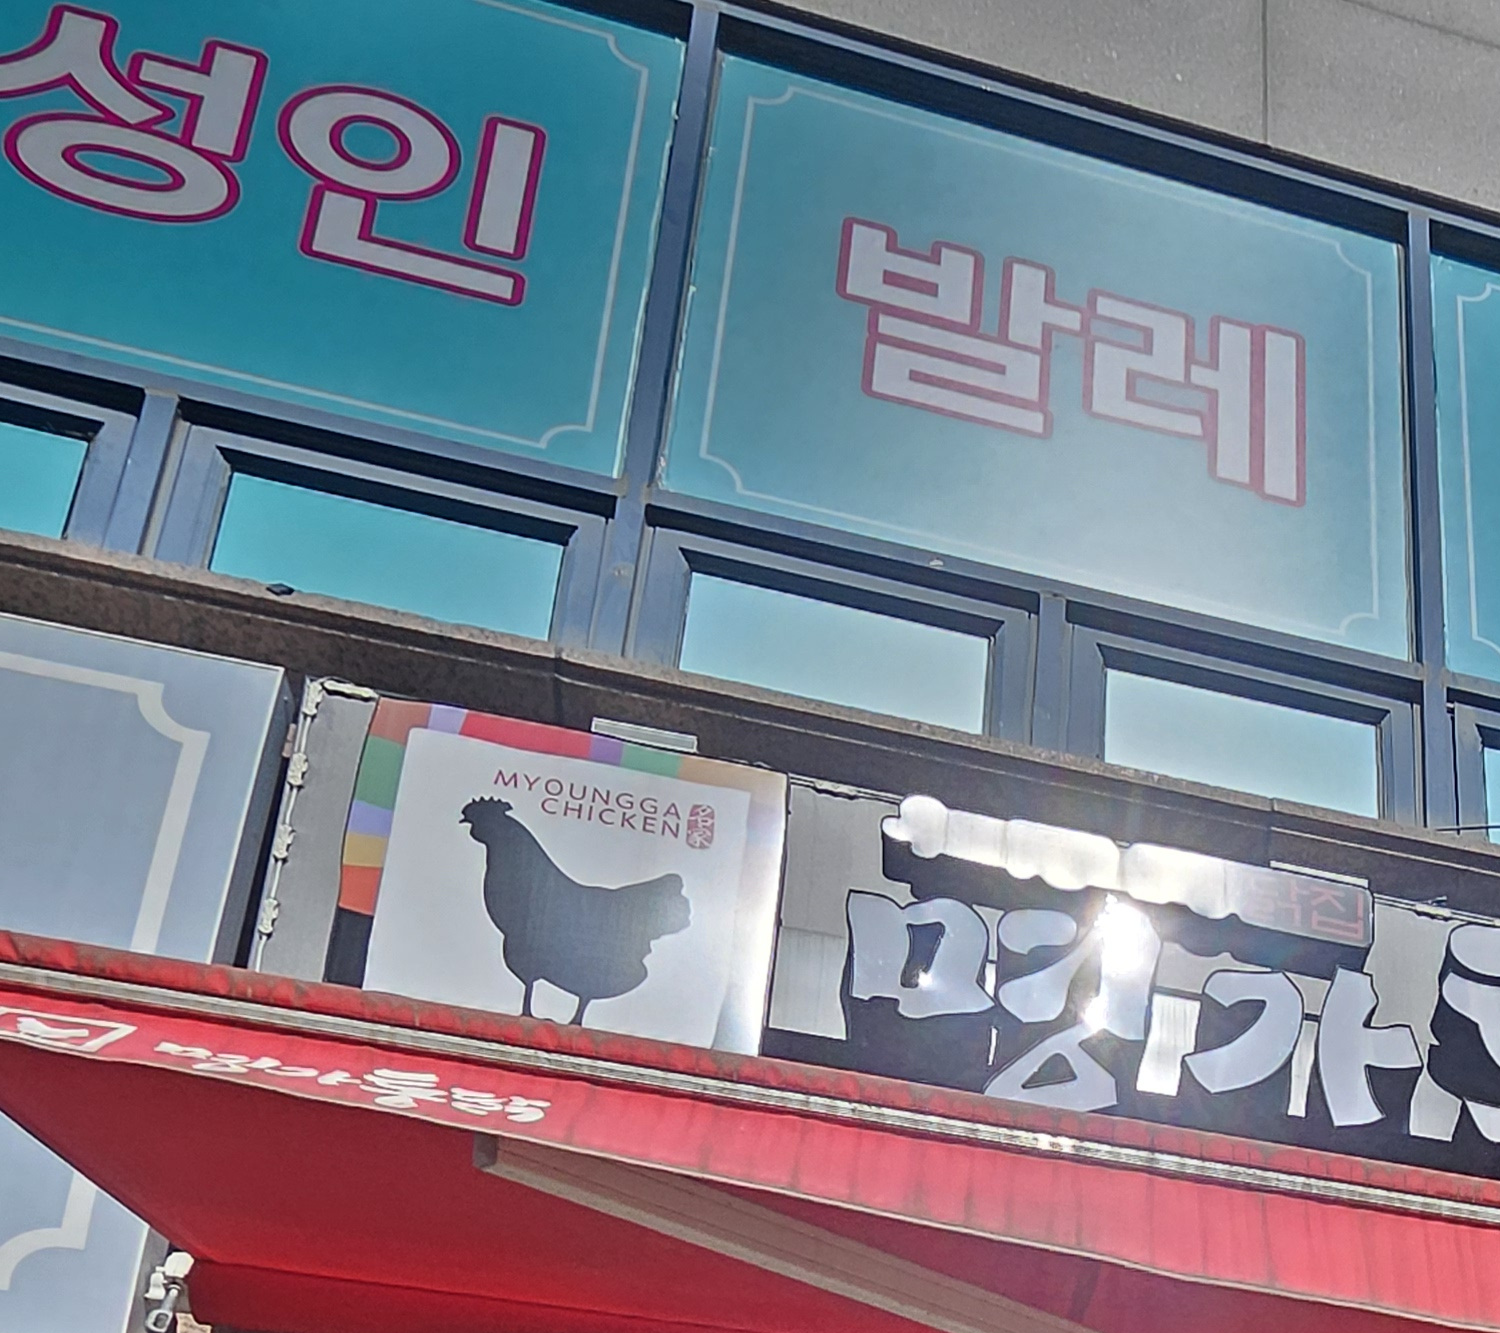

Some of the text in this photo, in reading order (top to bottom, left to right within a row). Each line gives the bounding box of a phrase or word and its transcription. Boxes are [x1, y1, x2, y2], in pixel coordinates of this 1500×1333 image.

[0, 3, 547, 307] 성인
[835, 216, 1306, 509] 발레
[494, 769, 682, 820] MYOUNGGA
[541, 798, 680, 839] CHICKEN
[154, 1039, 550, 1123] 명가통닭
